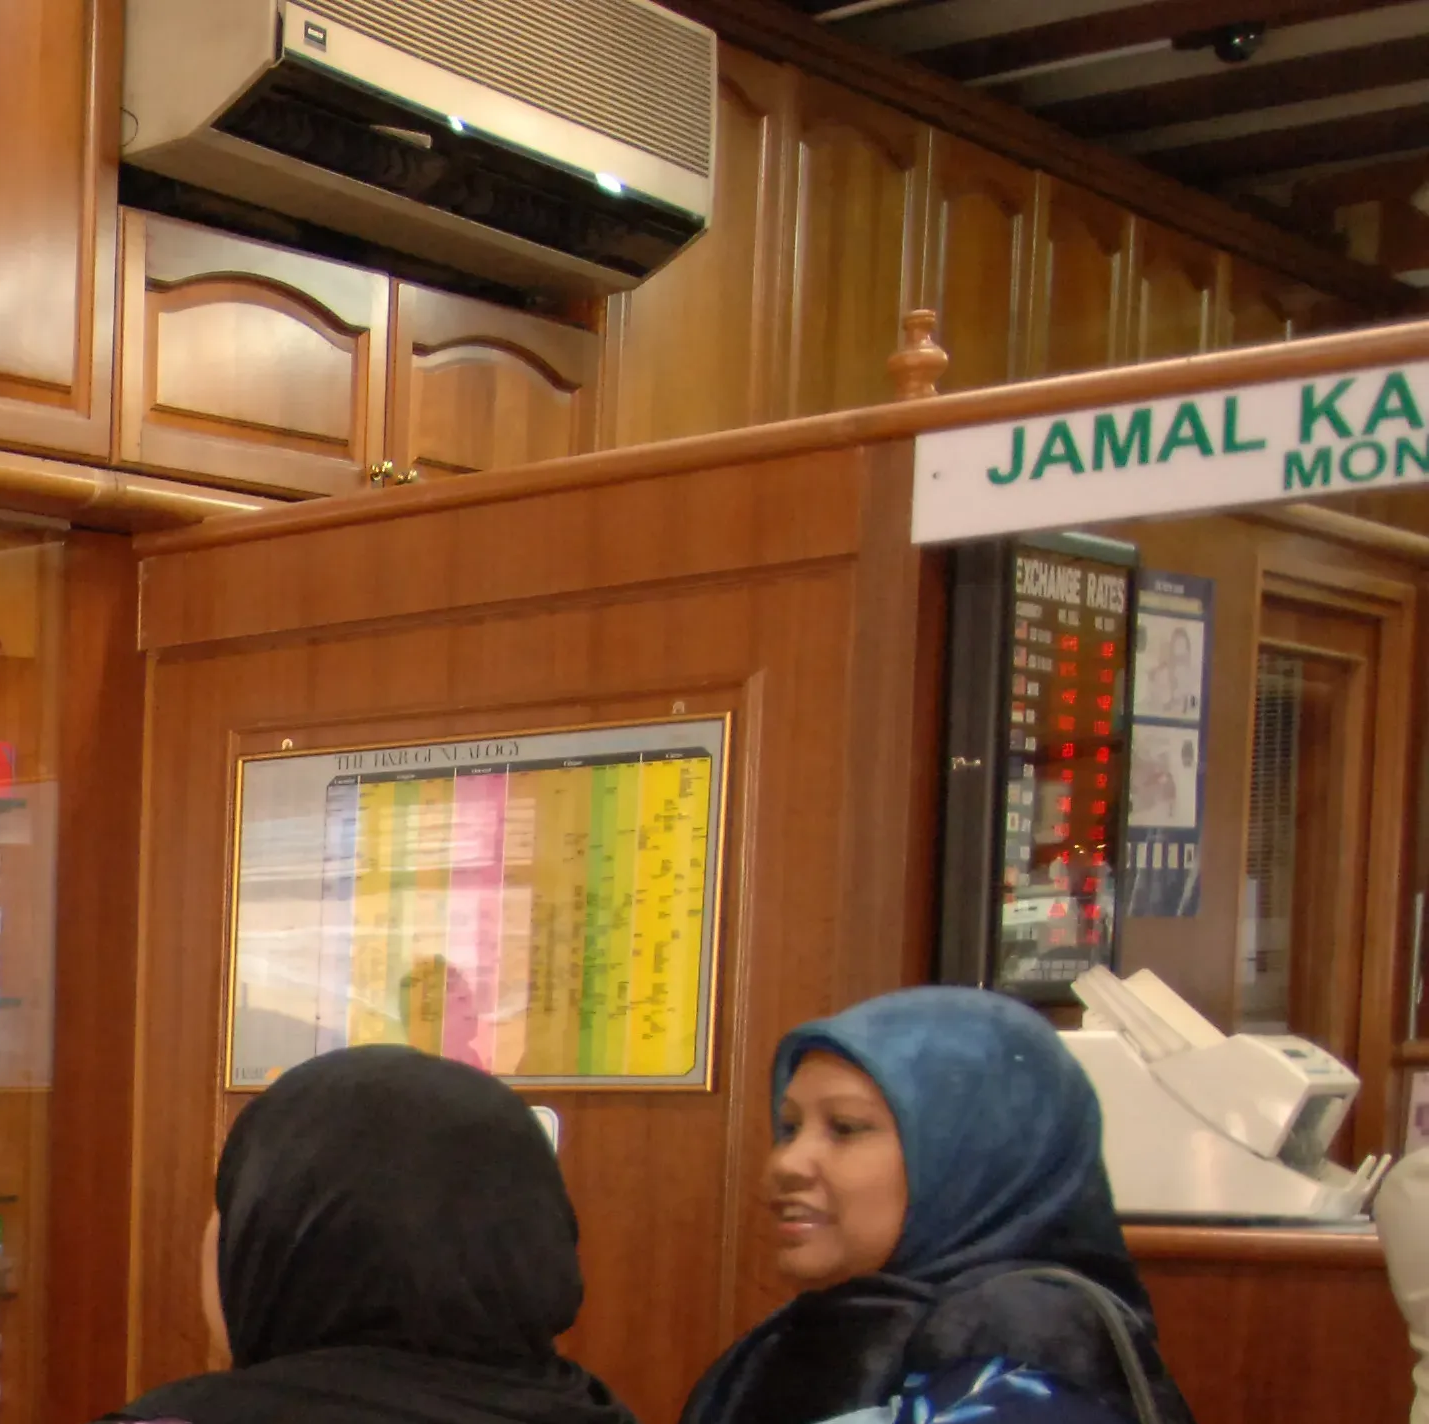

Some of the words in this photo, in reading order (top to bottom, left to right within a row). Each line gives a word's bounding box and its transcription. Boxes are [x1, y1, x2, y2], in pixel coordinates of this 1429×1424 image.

[987, 396, 1266, 486] JAMAL
[1015, 557, 1081, 604] EXCHANGE
[1086, 572, 1125, 613] RATES
